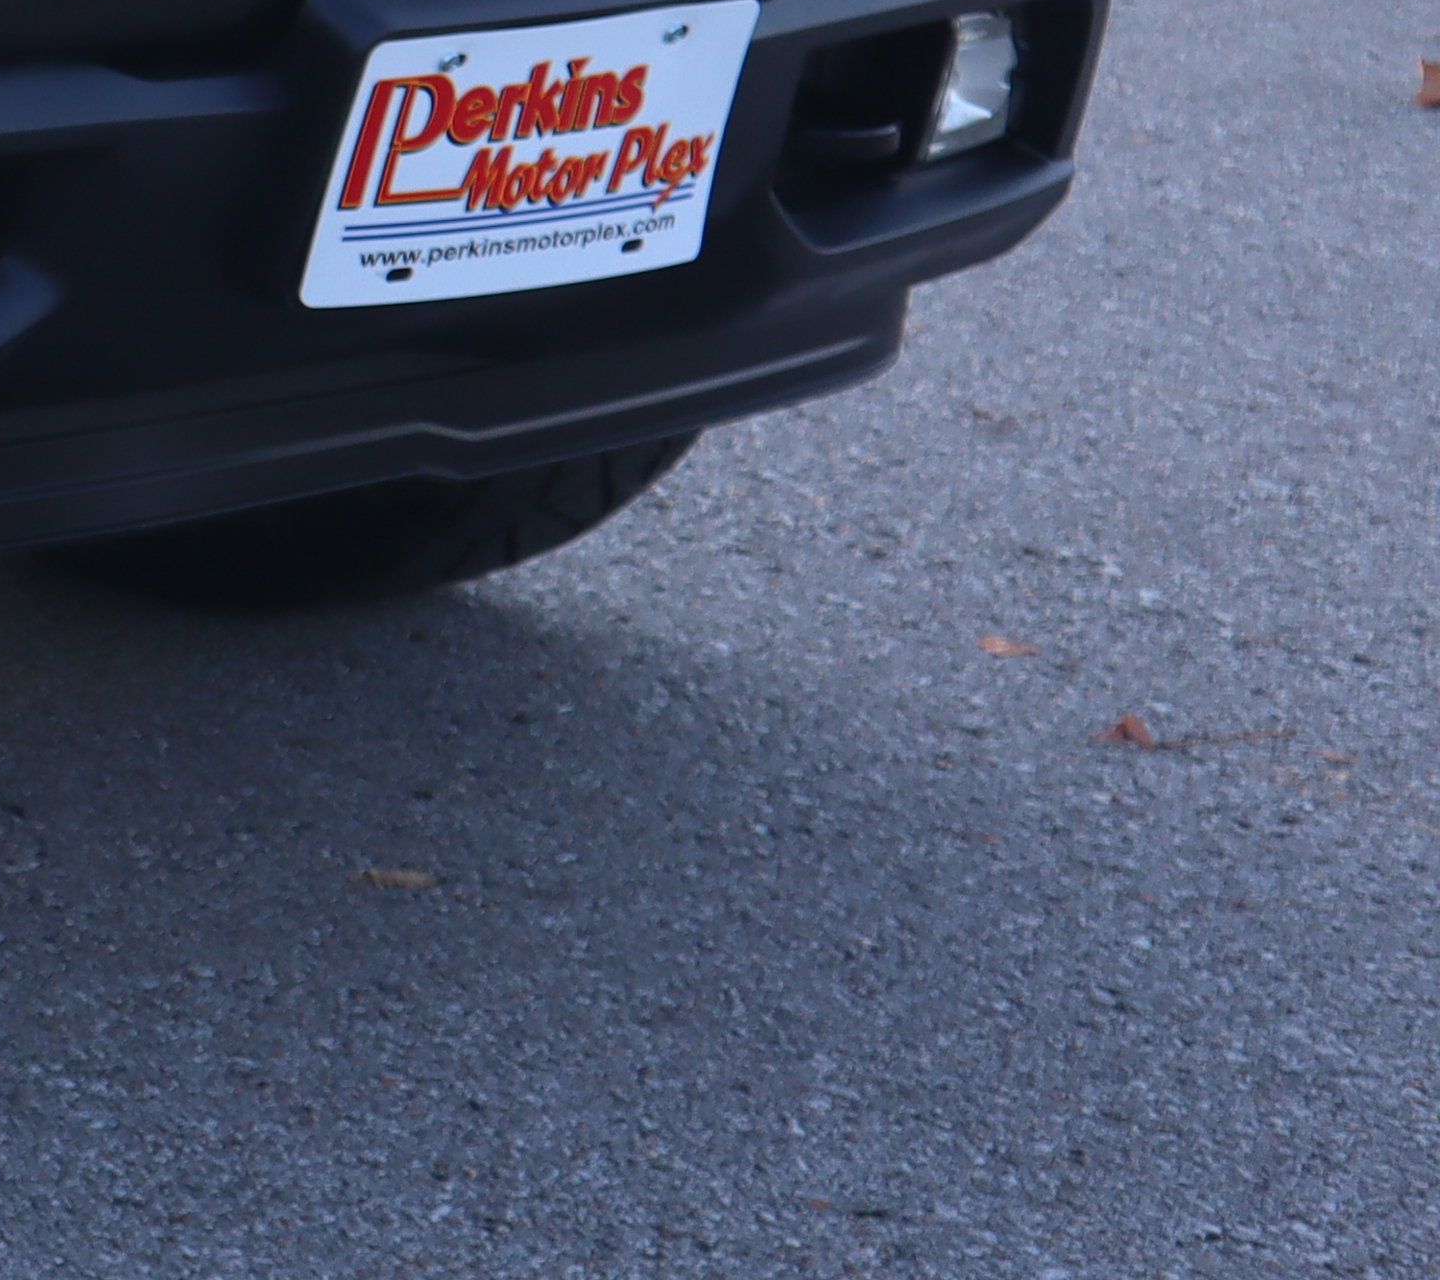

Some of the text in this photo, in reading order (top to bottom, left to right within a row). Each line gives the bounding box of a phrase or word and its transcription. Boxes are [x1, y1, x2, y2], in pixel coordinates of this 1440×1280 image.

[336, 56, 649, 211] Perkins
[465, 122, 714, 213] Motor Plex
[359, 213, 676, 269] www.perkinsmotorplex.com
